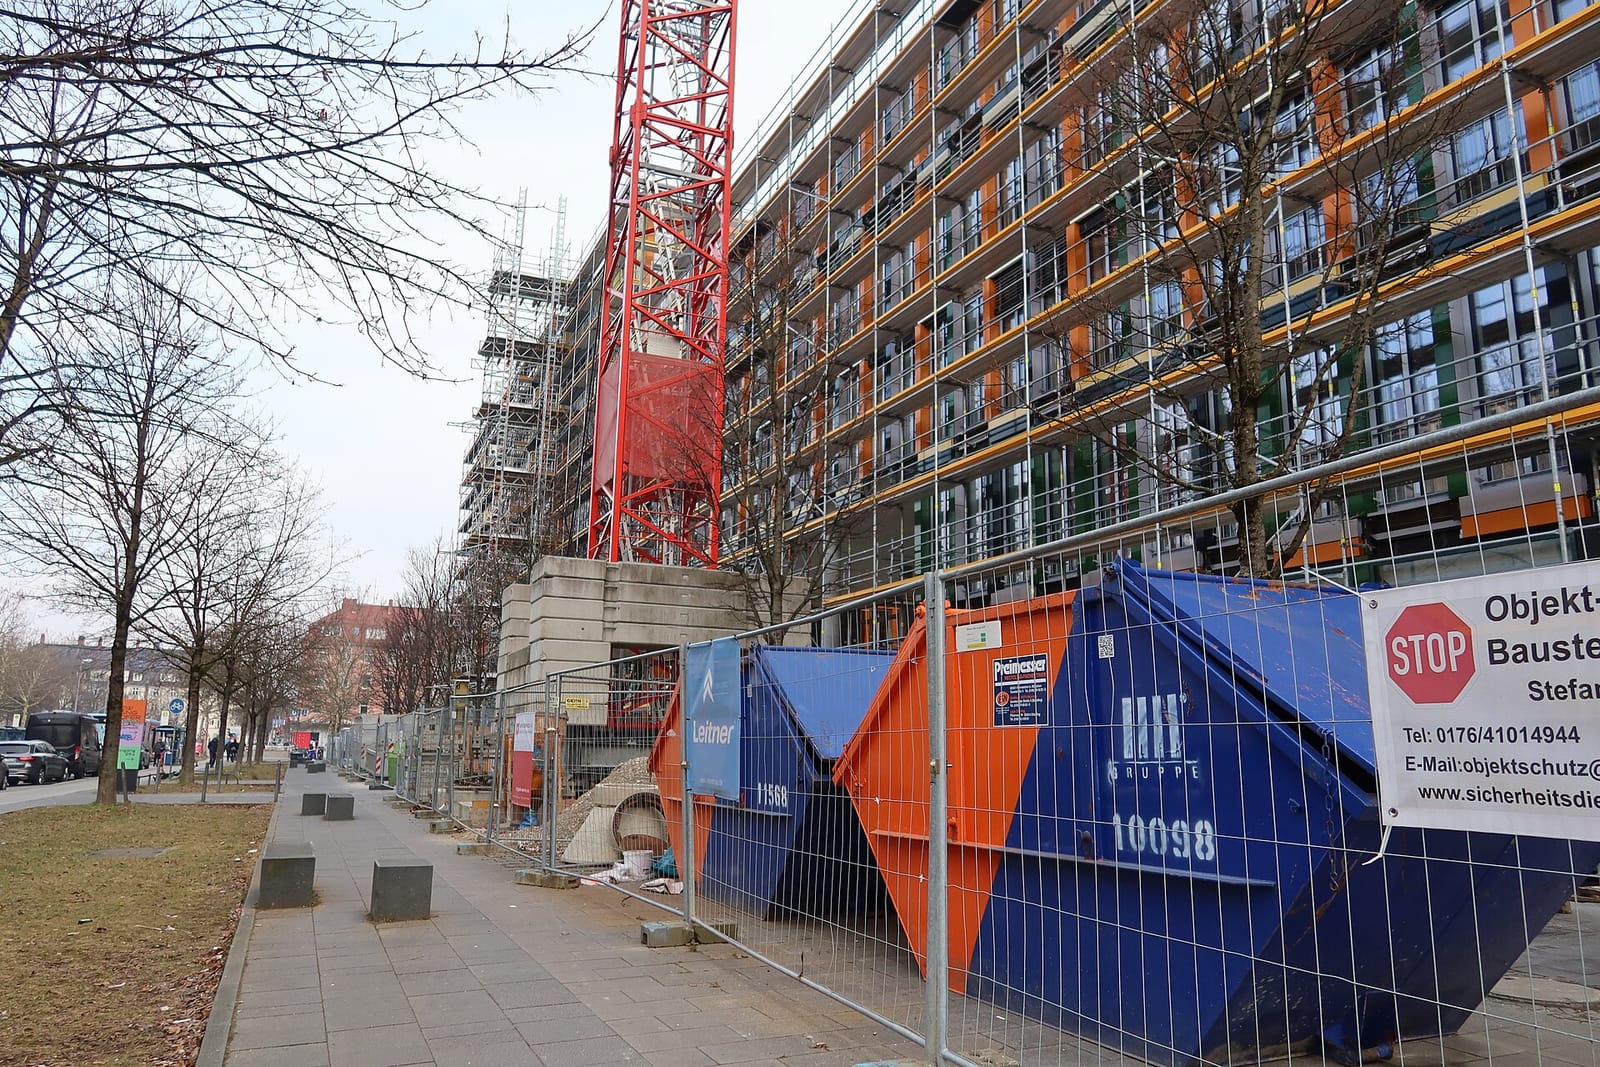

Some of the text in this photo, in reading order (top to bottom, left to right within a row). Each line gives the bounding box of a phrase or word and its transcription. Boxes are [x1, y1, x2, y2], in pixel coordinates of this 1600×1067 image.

[1391, 630, 1467, 676] STOP
[1487, 633, 1600, 665] Bauste
[994, 659, 1046, 682] Preimesser
[693, 720, 735, 745] Leitner
[1402, 726, 1581, 744] Tel: 0176/41014944
[1110, 766, 1199, 780] GRUPPE
[758, 782, 788, 808] 11568
[1112, 812, 1215, 861] 10098
